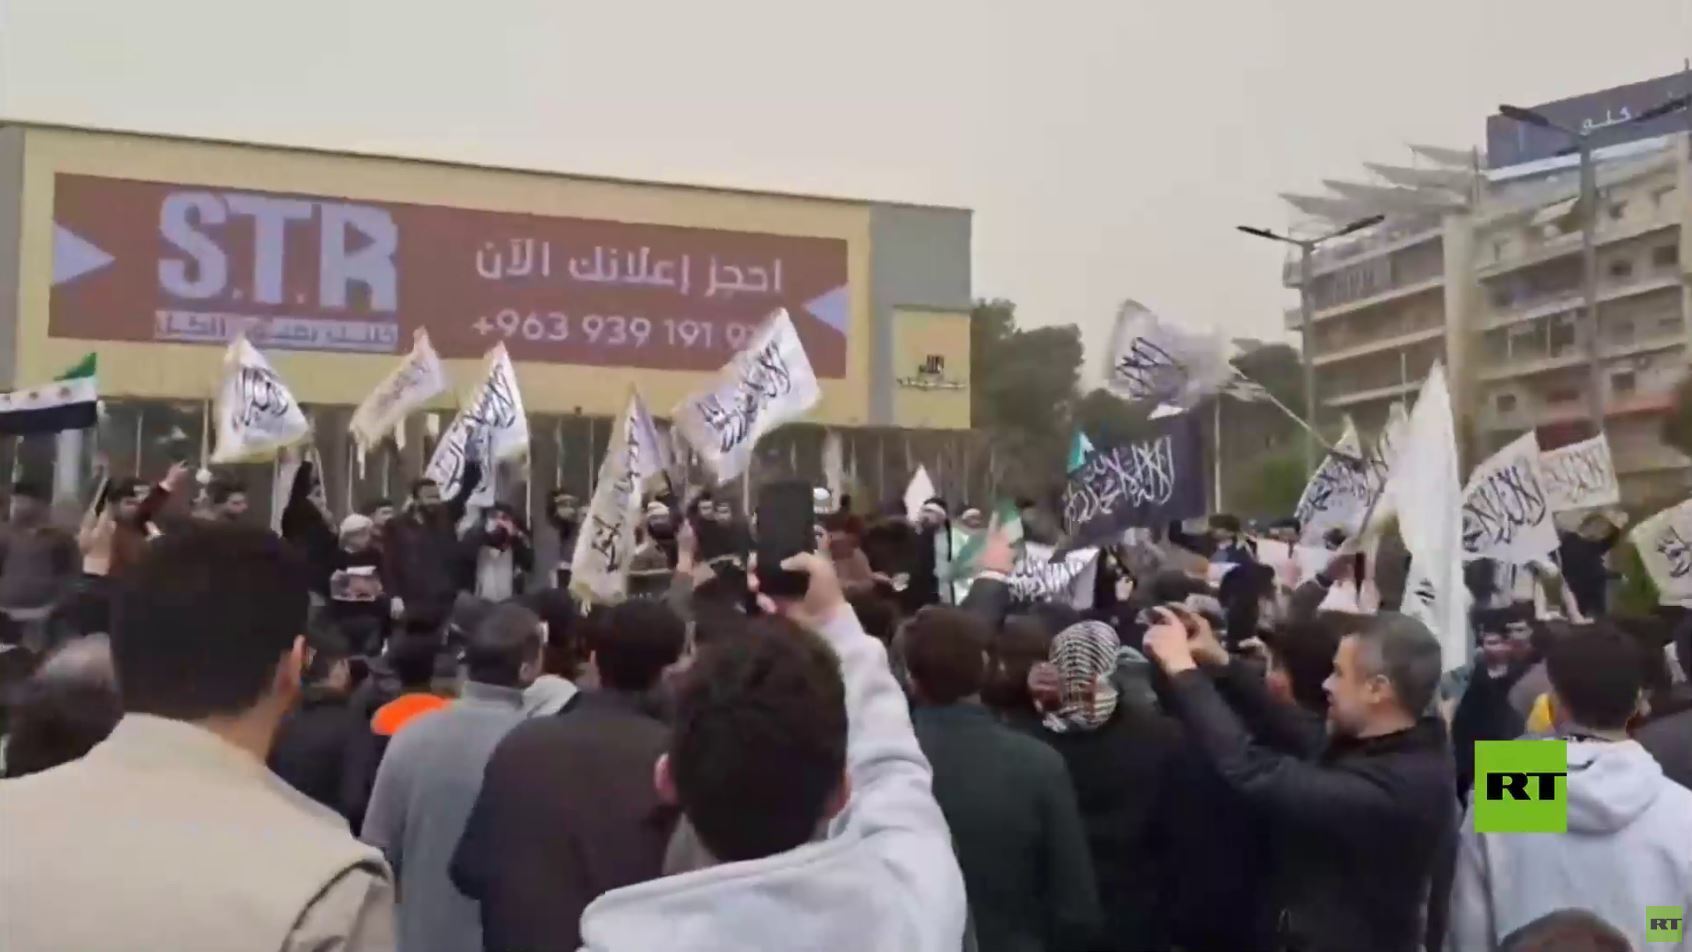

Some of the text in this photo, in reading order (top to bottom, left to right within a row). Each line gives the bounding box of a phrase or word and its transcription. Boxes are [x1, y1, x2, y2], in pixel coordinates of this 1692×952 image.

[475, 238, 783, 297] احجز إعلانك الآن
[473, 308, 568, 341] +963
[582, 314, 650, 348] 939
[664, 319, 712, 347] 191
